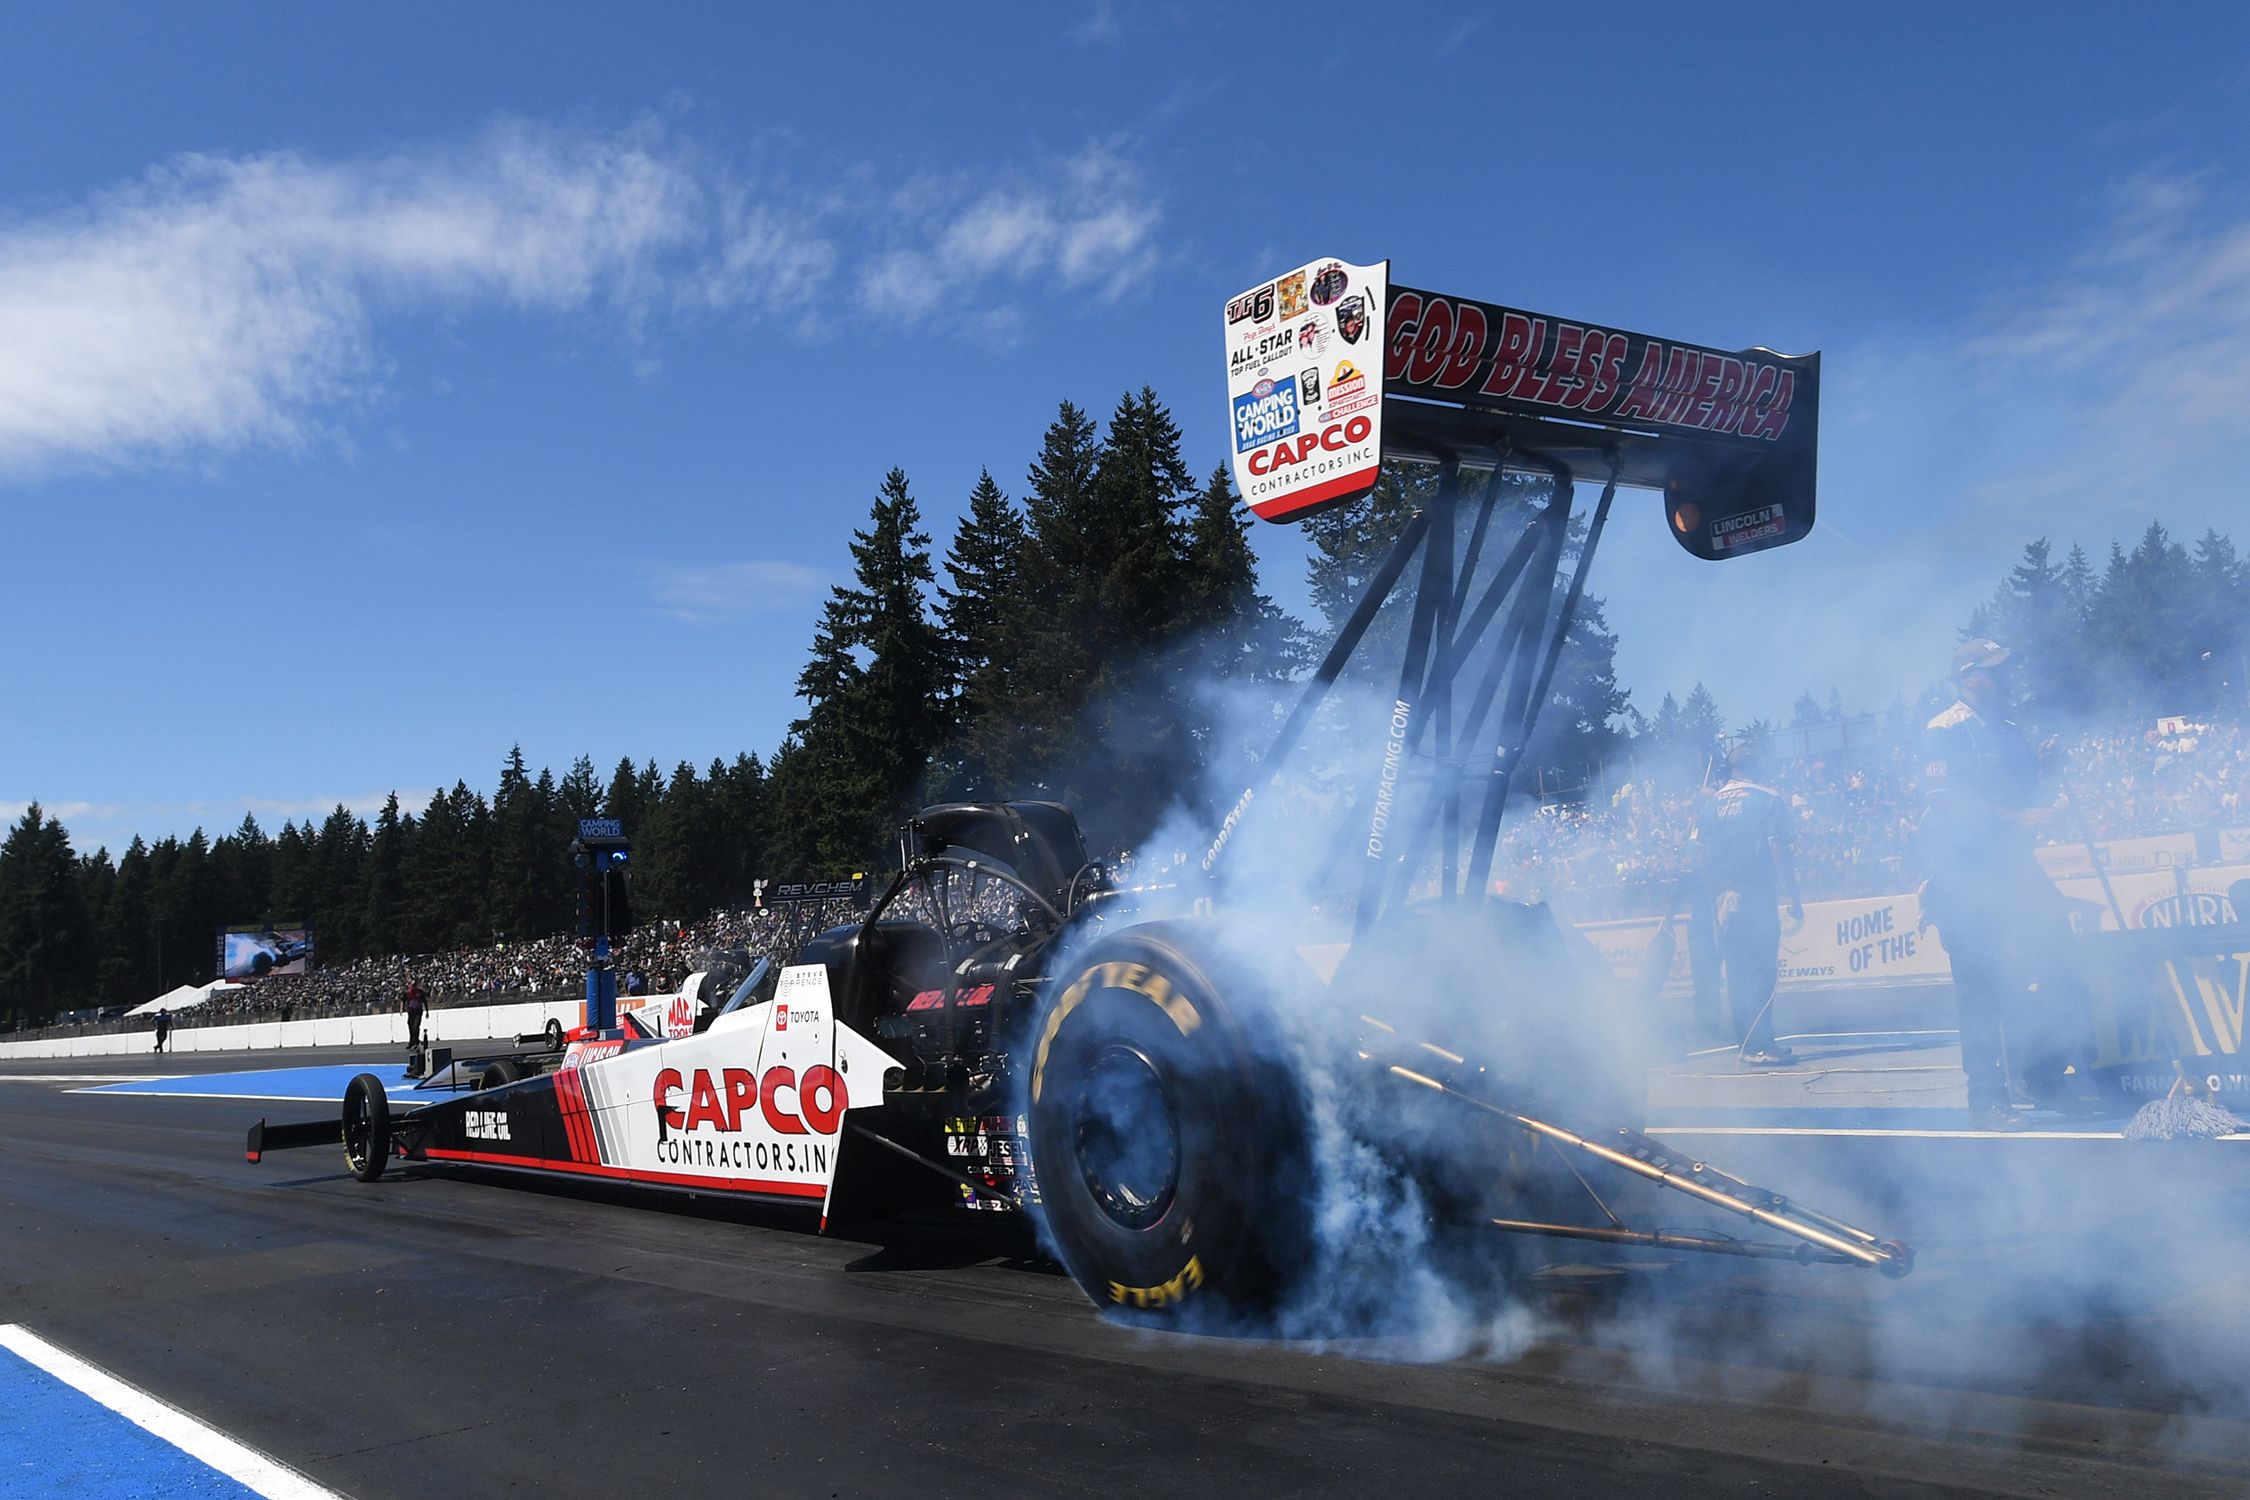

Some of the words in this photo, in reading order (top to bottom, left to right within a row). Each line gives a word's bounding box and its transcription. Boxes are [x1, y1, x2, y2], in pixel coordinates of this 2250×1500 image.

[1231, 366, 1243, 378] TOP
[1245, 359, 1261, 372] FUEL
[1263, 346, 1292, 364] CALLOUT
[1386, 292, 1488, 389] GOD
[1479, 311, 1628, 414] BLESS
[1616, 340, 1796, 441] AMERICA
[1237, 388, 1294, 423] CAMPING
[1237, 405, 1296, 440] WORLD
[1332, 396, 1378, 419] CHALLENGE
[1248, 415, 1372, 476] CAPCO
[1251, 457, 1343, 496] CONTRACTORS
[1714, 509, 1771, 535] LINCOLN
[1728, 523, 1778, 544] WELDERS
[1367, 699, 1411, 861] TOYOTARACING.COM
[580, 819, 620, 828] CAMPING
[580, 826, 620, 837] WORLD
[1201, 787, 1254, 871] GOODYEAR
[777, 880, 864, 896] REVCHEM
[1836, 906, 1894, 946] HOME
[1849, 943, 1873, 973] OF
[1878, 931, 1917, 964] THE
[797, 971, 823, 979] STEVE
[668, 997, 693, 1027] MAC
[790, 1011, 820, 1023] TOYOTA
[653, 1065, 849, 1135] CAPCO
[1108, 1254, 1205, 1309] EAGLE
